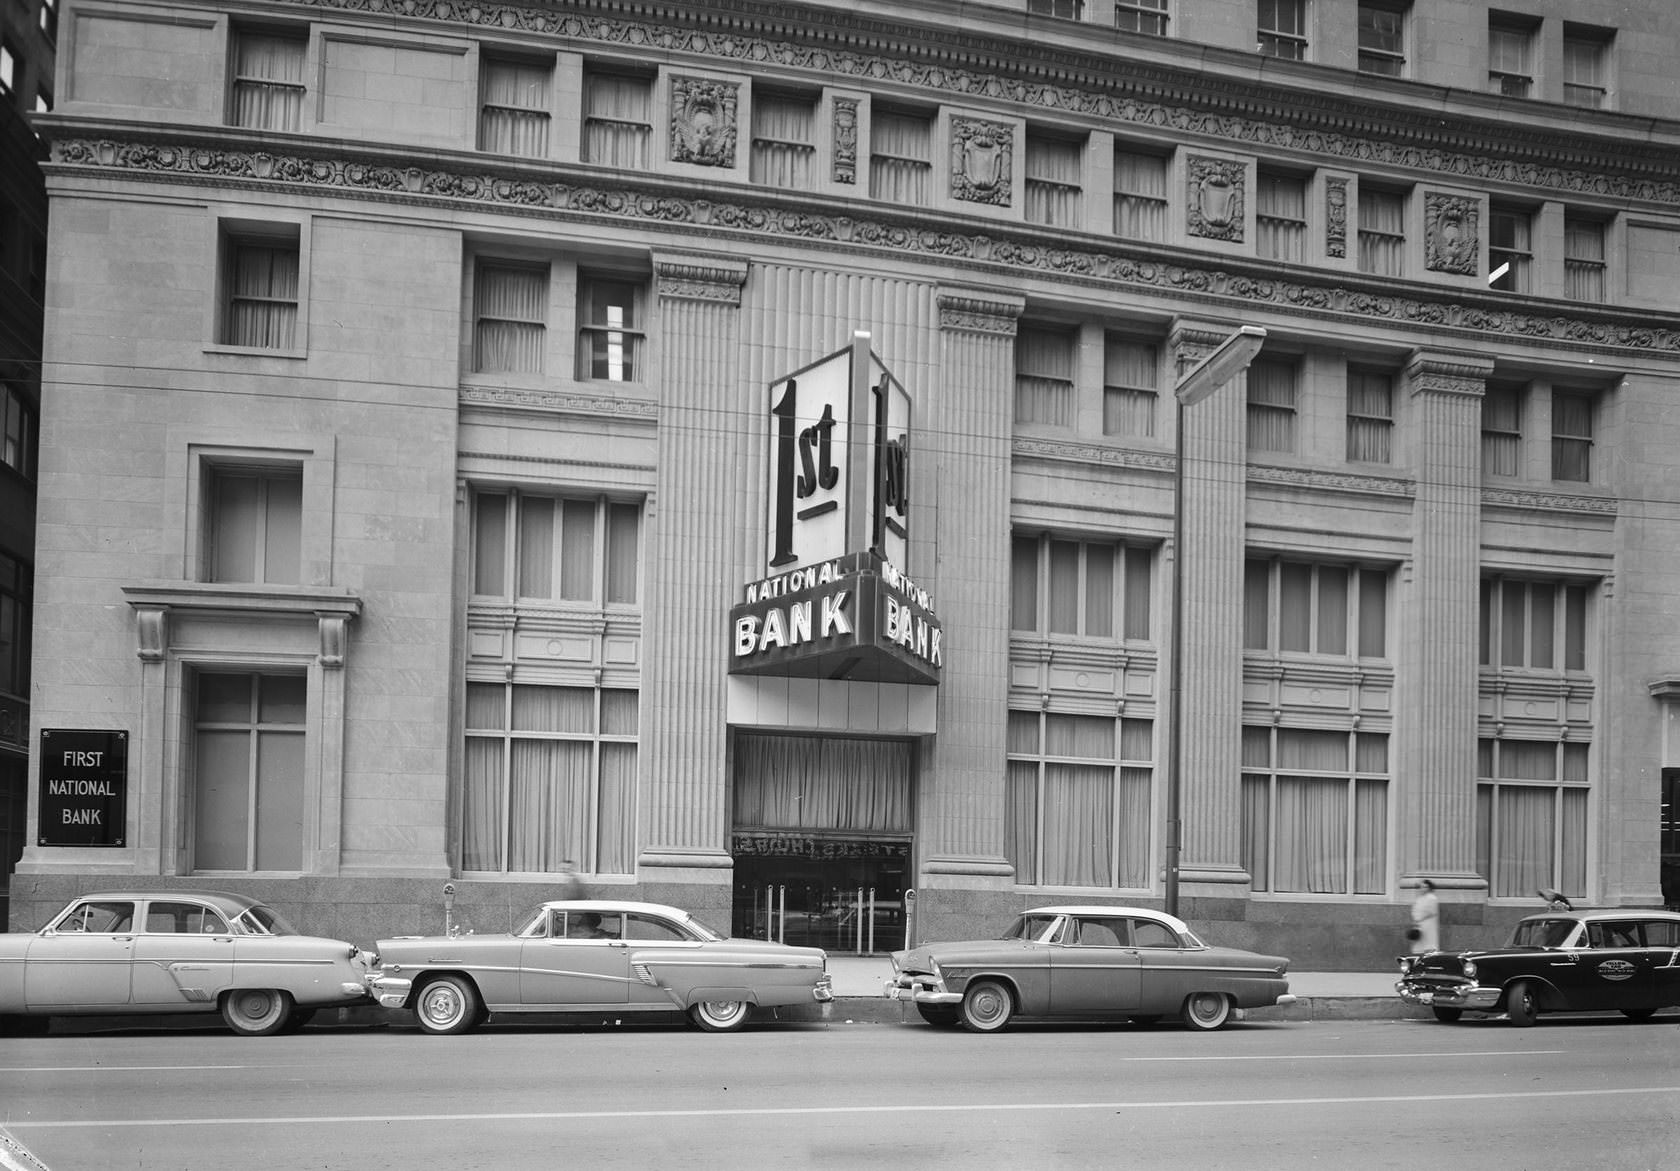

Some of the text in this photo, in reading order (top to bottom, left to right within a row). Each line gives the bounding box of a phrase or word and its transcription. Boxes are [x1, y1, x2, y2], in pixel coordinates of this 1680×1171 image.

[746, 559, 844, 605] NATIONAL
[735, 590, 854, 657] BANK
[883, 595, 943, 669] BANK
[63, 751, 104, 767] FIRST
[48, 779, 117, 796] NATIONAL
[62, 808, 102, 825] BANK
